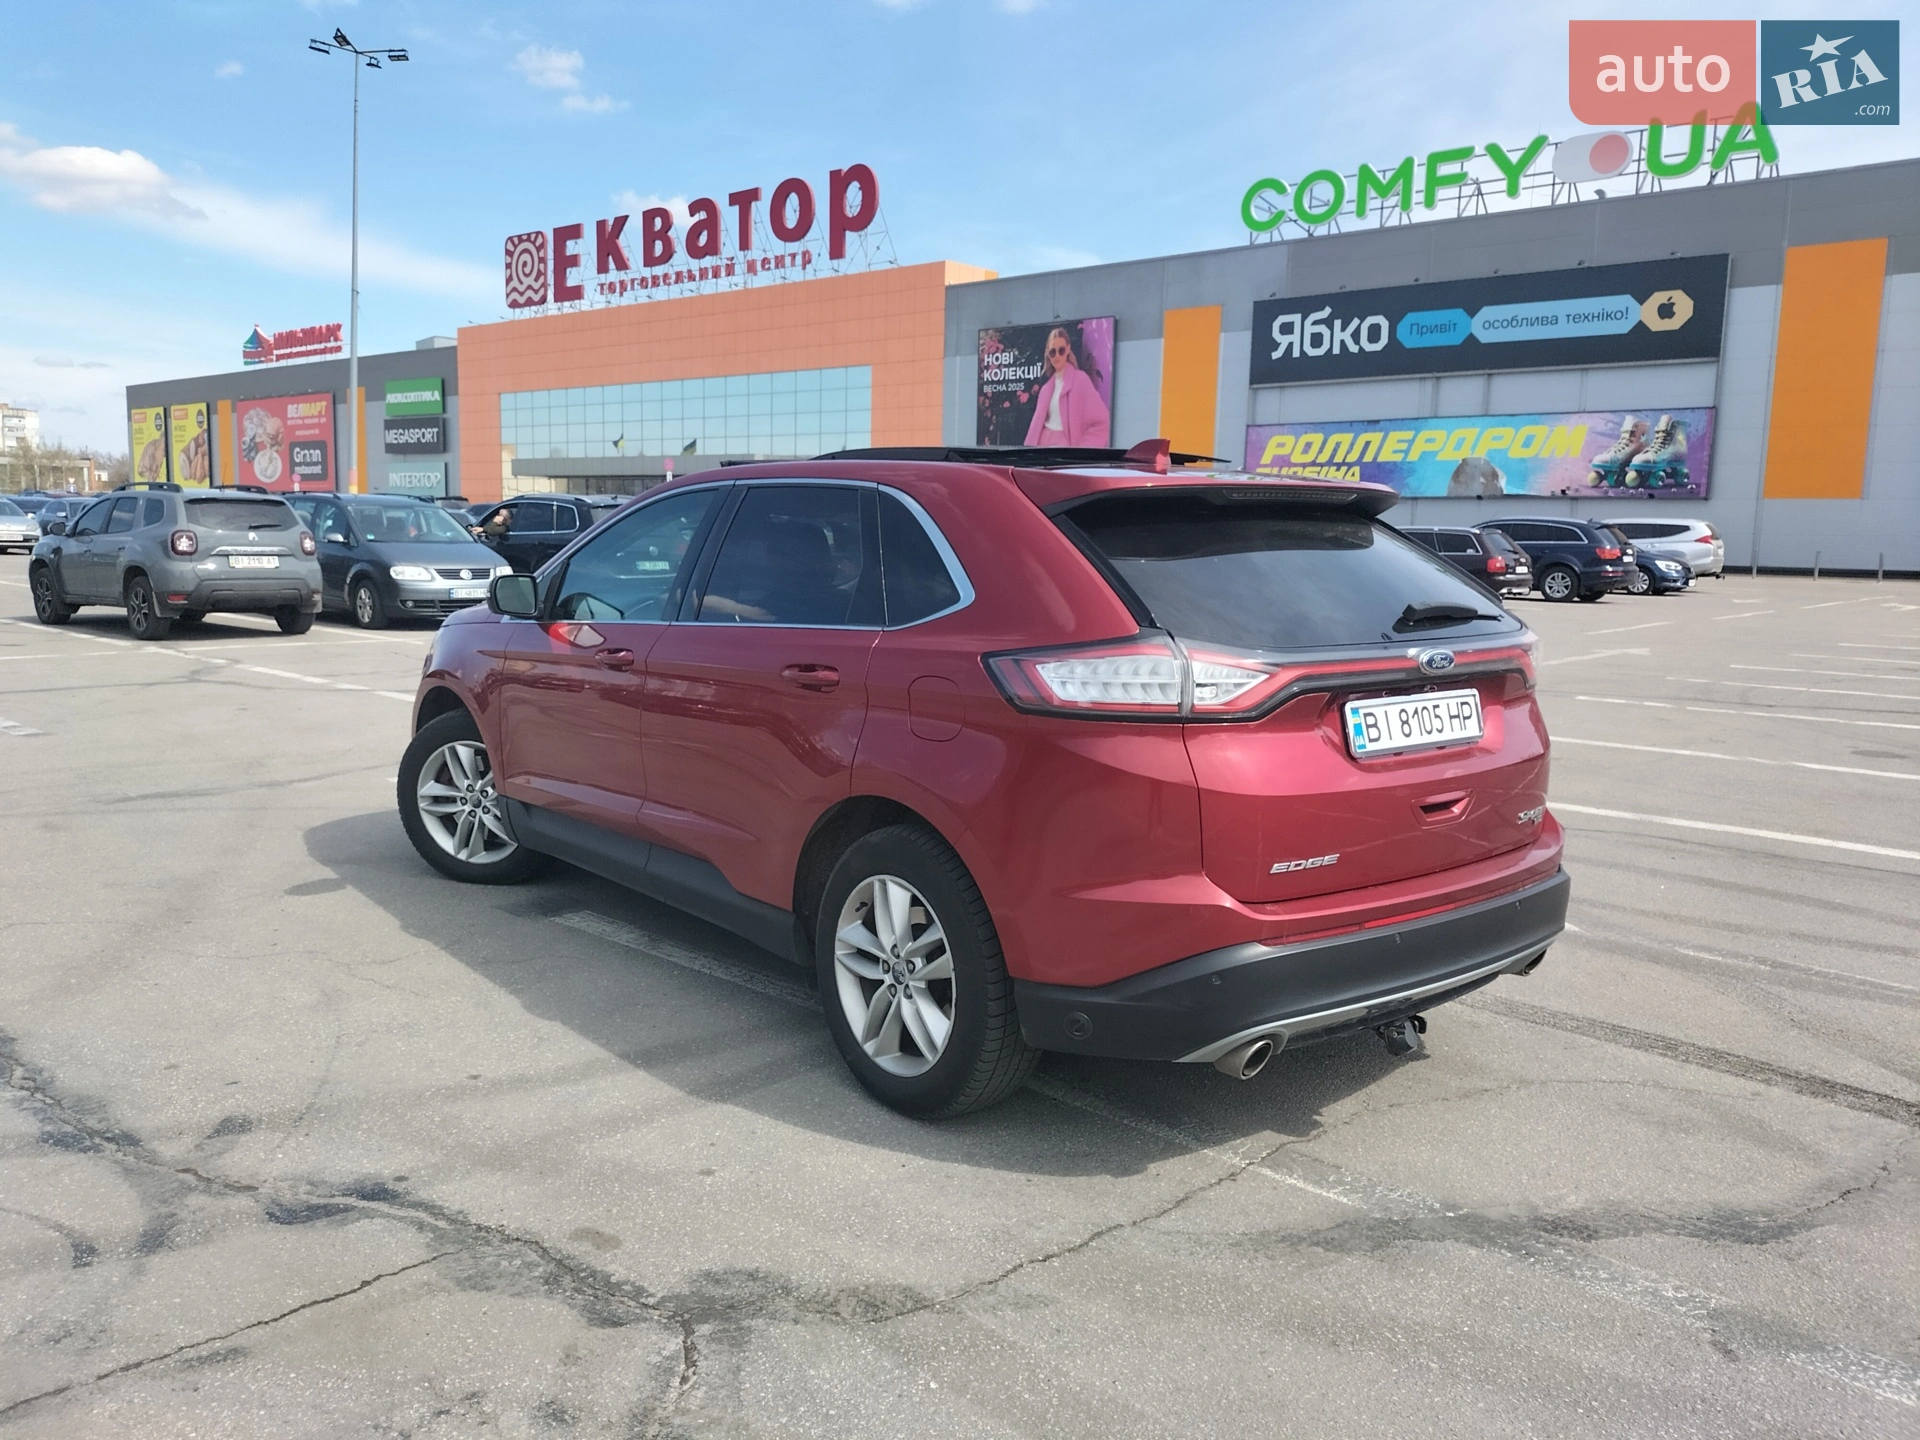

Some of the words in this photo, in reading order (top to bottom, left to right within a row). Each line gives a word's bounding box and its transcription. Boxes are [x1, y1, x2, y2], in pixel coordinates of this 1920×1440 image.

[1240, 134, 1552, 233] COMFY
[598, 257, 736, 297] торговельний
[746, 250, 813, 276] центр
[1409, 320, 1458, 337] Привіт
[1481, 314, 1560, 331] особлива
[1565, 305, 1630, 325] техніко!
[1271, 306, 1389, 360] Ябко
[984, 351, 1014, 366] НОВІ
[983, 363, 1042, 382] КОЛЕКЦІЇ
[983, 384, 1007, 393] ВЕСНА
[1007, 382, 1025, 391] 2025
[385, 428, 439, 444] MEGASPORT
[1260, 425, 1590, 465] РОЛЛЕРДРОМ
[389, 472, 441, 488] INTERTOP
[1431, 654, 1450, 668] Ford
[1363, 711, 1393, 743] BI
[1398, 704, 1444, 738] 8105
[1447, 701, 1473, 733] HP
[1269, 853, 1341, 874] EDGE
